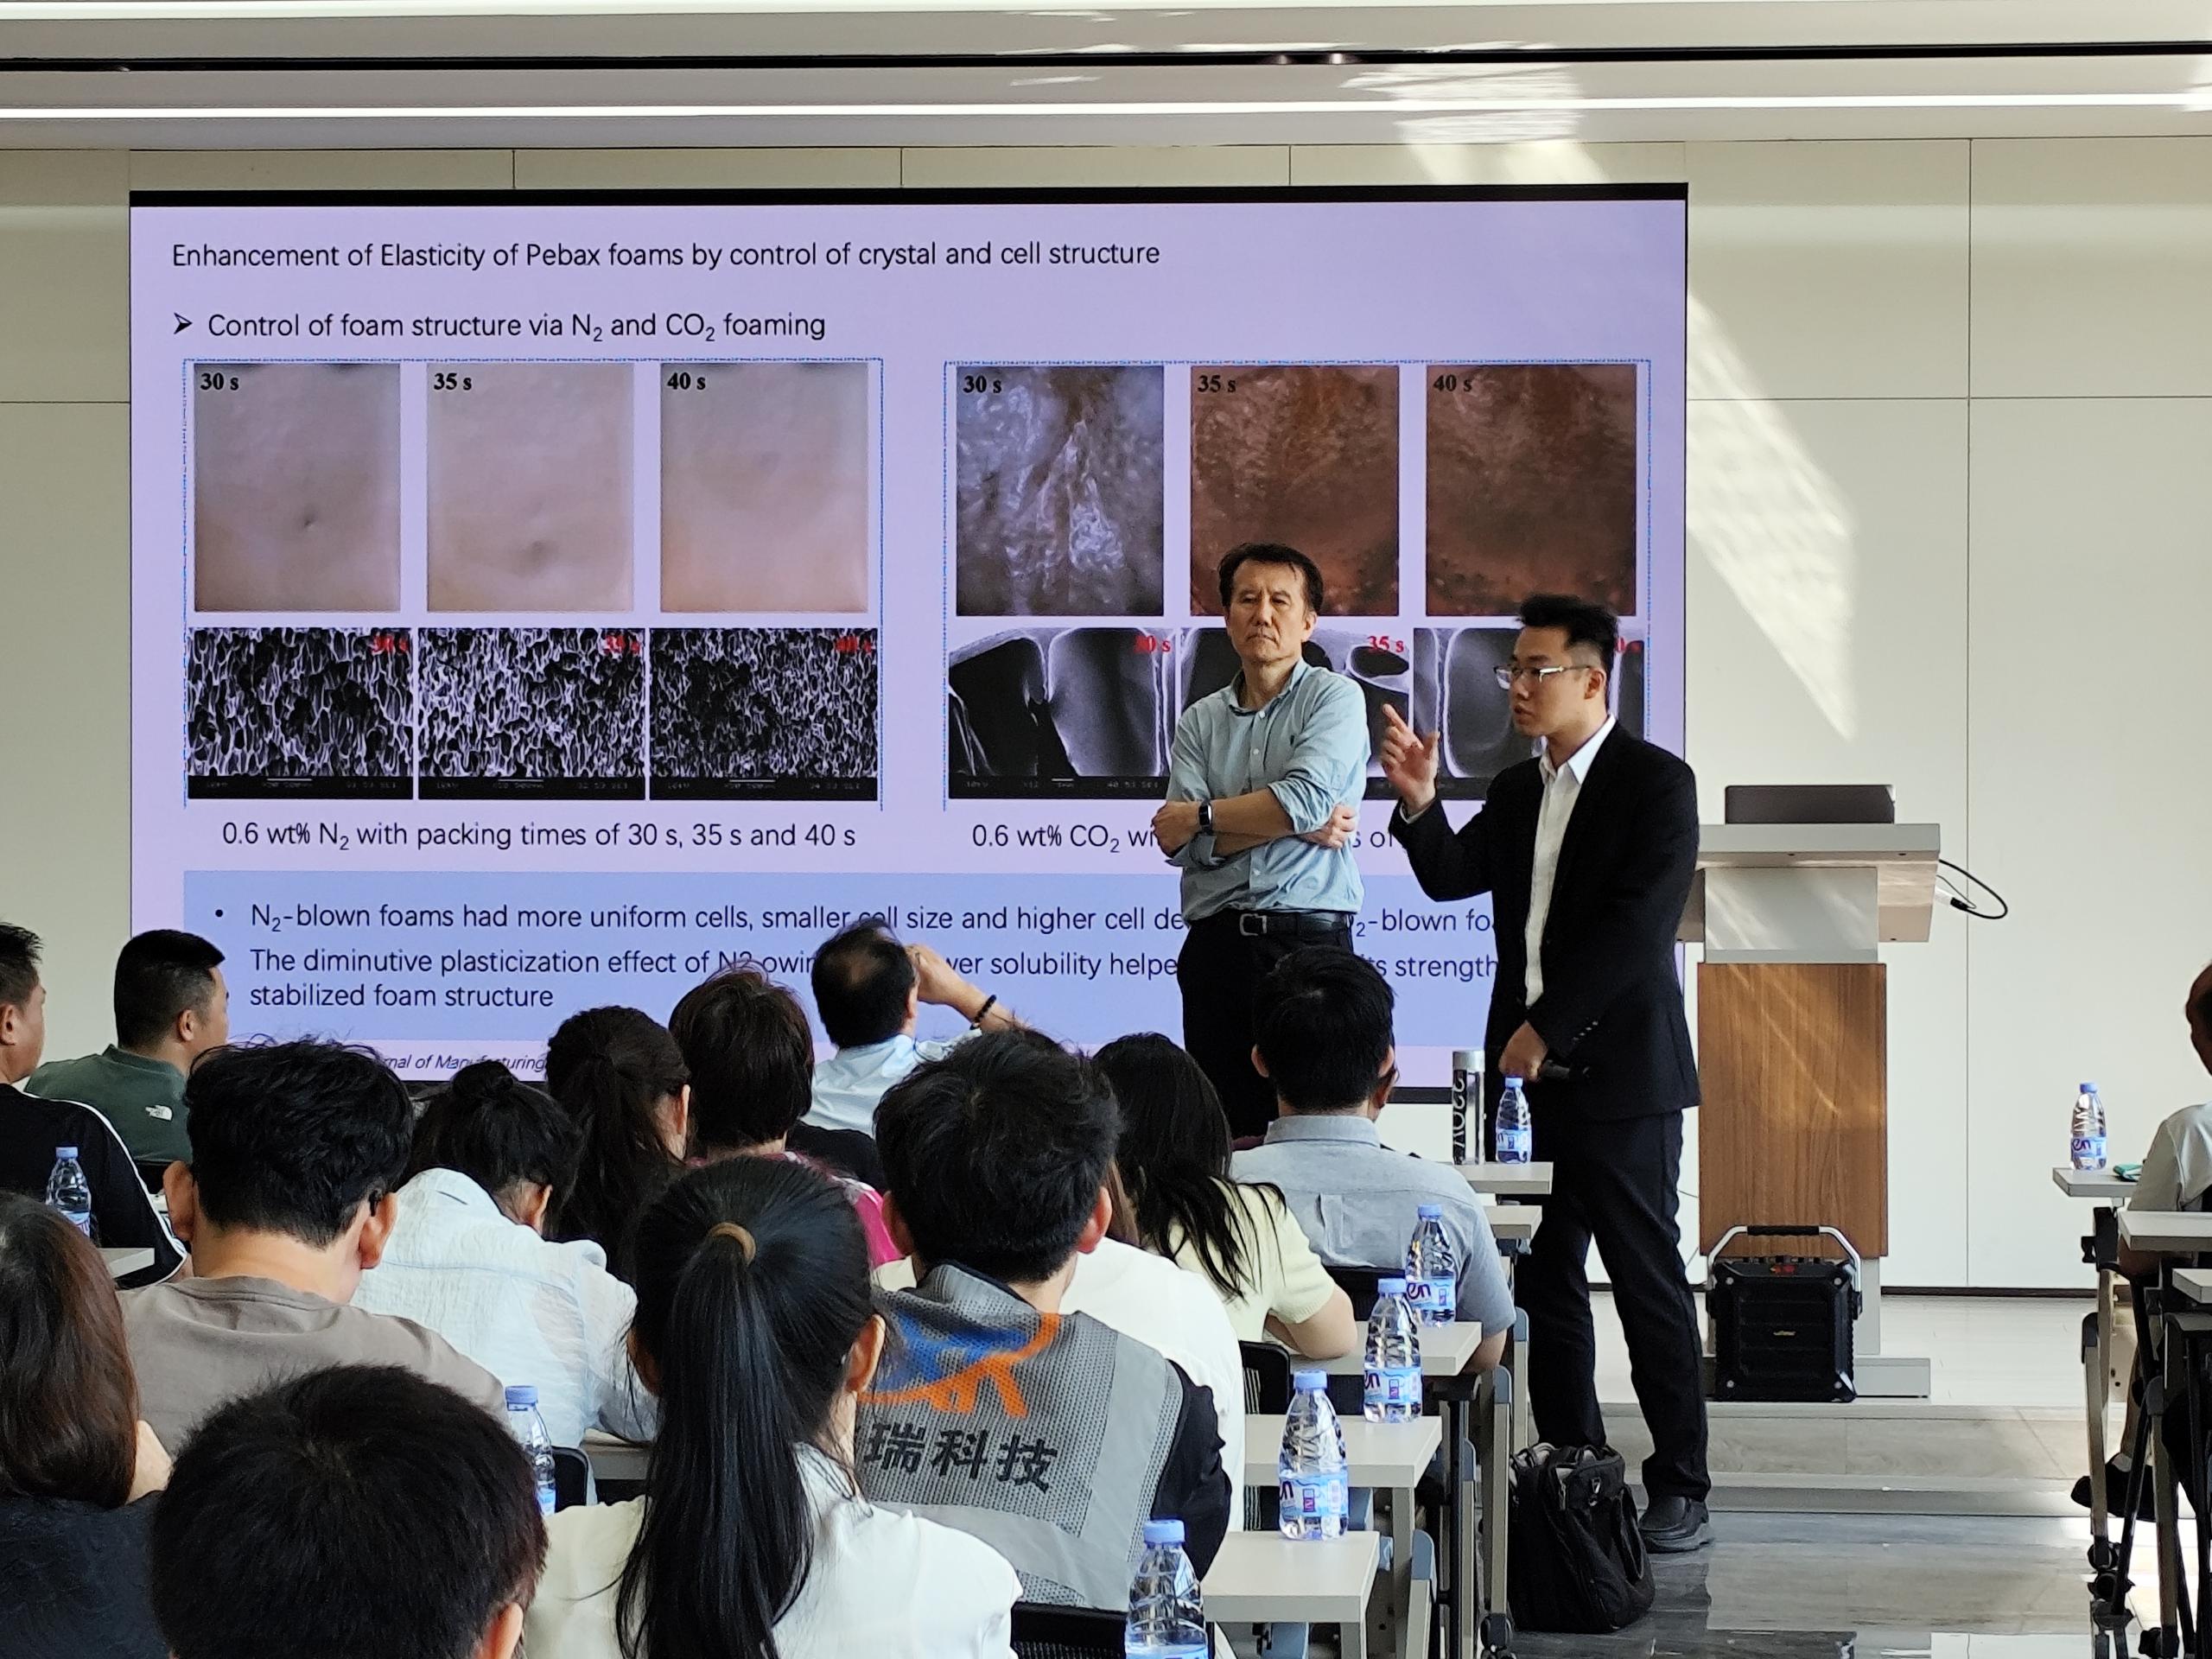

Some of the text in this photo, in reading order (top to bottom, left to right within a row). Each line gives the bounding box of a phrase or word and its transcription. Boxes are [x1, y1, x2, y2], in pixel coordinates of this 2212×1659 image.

[174, 241, 1160, 270] Enhancement of Elasticity of Pebax foams by control of crystal and cell structure
[209, 312, 824, 341] Control of foam structure via N2 and CO2 foaming
[200, 372, 239, 391] 30 s
[434, 372, 472, 391] 35 s
[667, 372, 706, 391] 40 s
[963, 375, 1001, 393] 30 s
[1198, 374, 1236, 392] 35 s
[1433, 374, 1472, 392] 40 s
[1161, 640, 1171, 653] s
[1367, 635, 1390, 654] 35
[224, 823, 855, 850] 0.6 wt% N2 with packing times of 30 s, 35 s and 40 s
[973, 824, 1007, 846] 0.6
[1018, 825, 1061, 846] wt%
[1071, 825, 1119, 853] CO2
[379, 904, 454, 926] foams
[464, 904, 507, 926] had
[518, 911, 582, 926] more
[591, 905, 685, 927] uniform
[696, 906, 753, 931] cells,
[762, 906, 850, 929] smaller
[907, 906, 952, 928] size
[963, 906, 1007, 929] and
[1018, 906, 1096, 934] higher
[1105, 907, 1143, 930] cell
[1466, 908, 1494, 931] fo
[250, 949, 295, 970] The
[304, 949, 432, 971] diminutive
[442, 950, 599, 977] plasticization
[608, 950, 676, 972] effect
[685, 950, 710, 973] of
[947, 957, 983, 974] ver
[991, 952, 1101, 980] solubility
[251, 983, 553, 1007] stabilized foam structure
[415, 1054, 434, 1069] of
[864, 1422, 1058, 1494] 瑞科技
